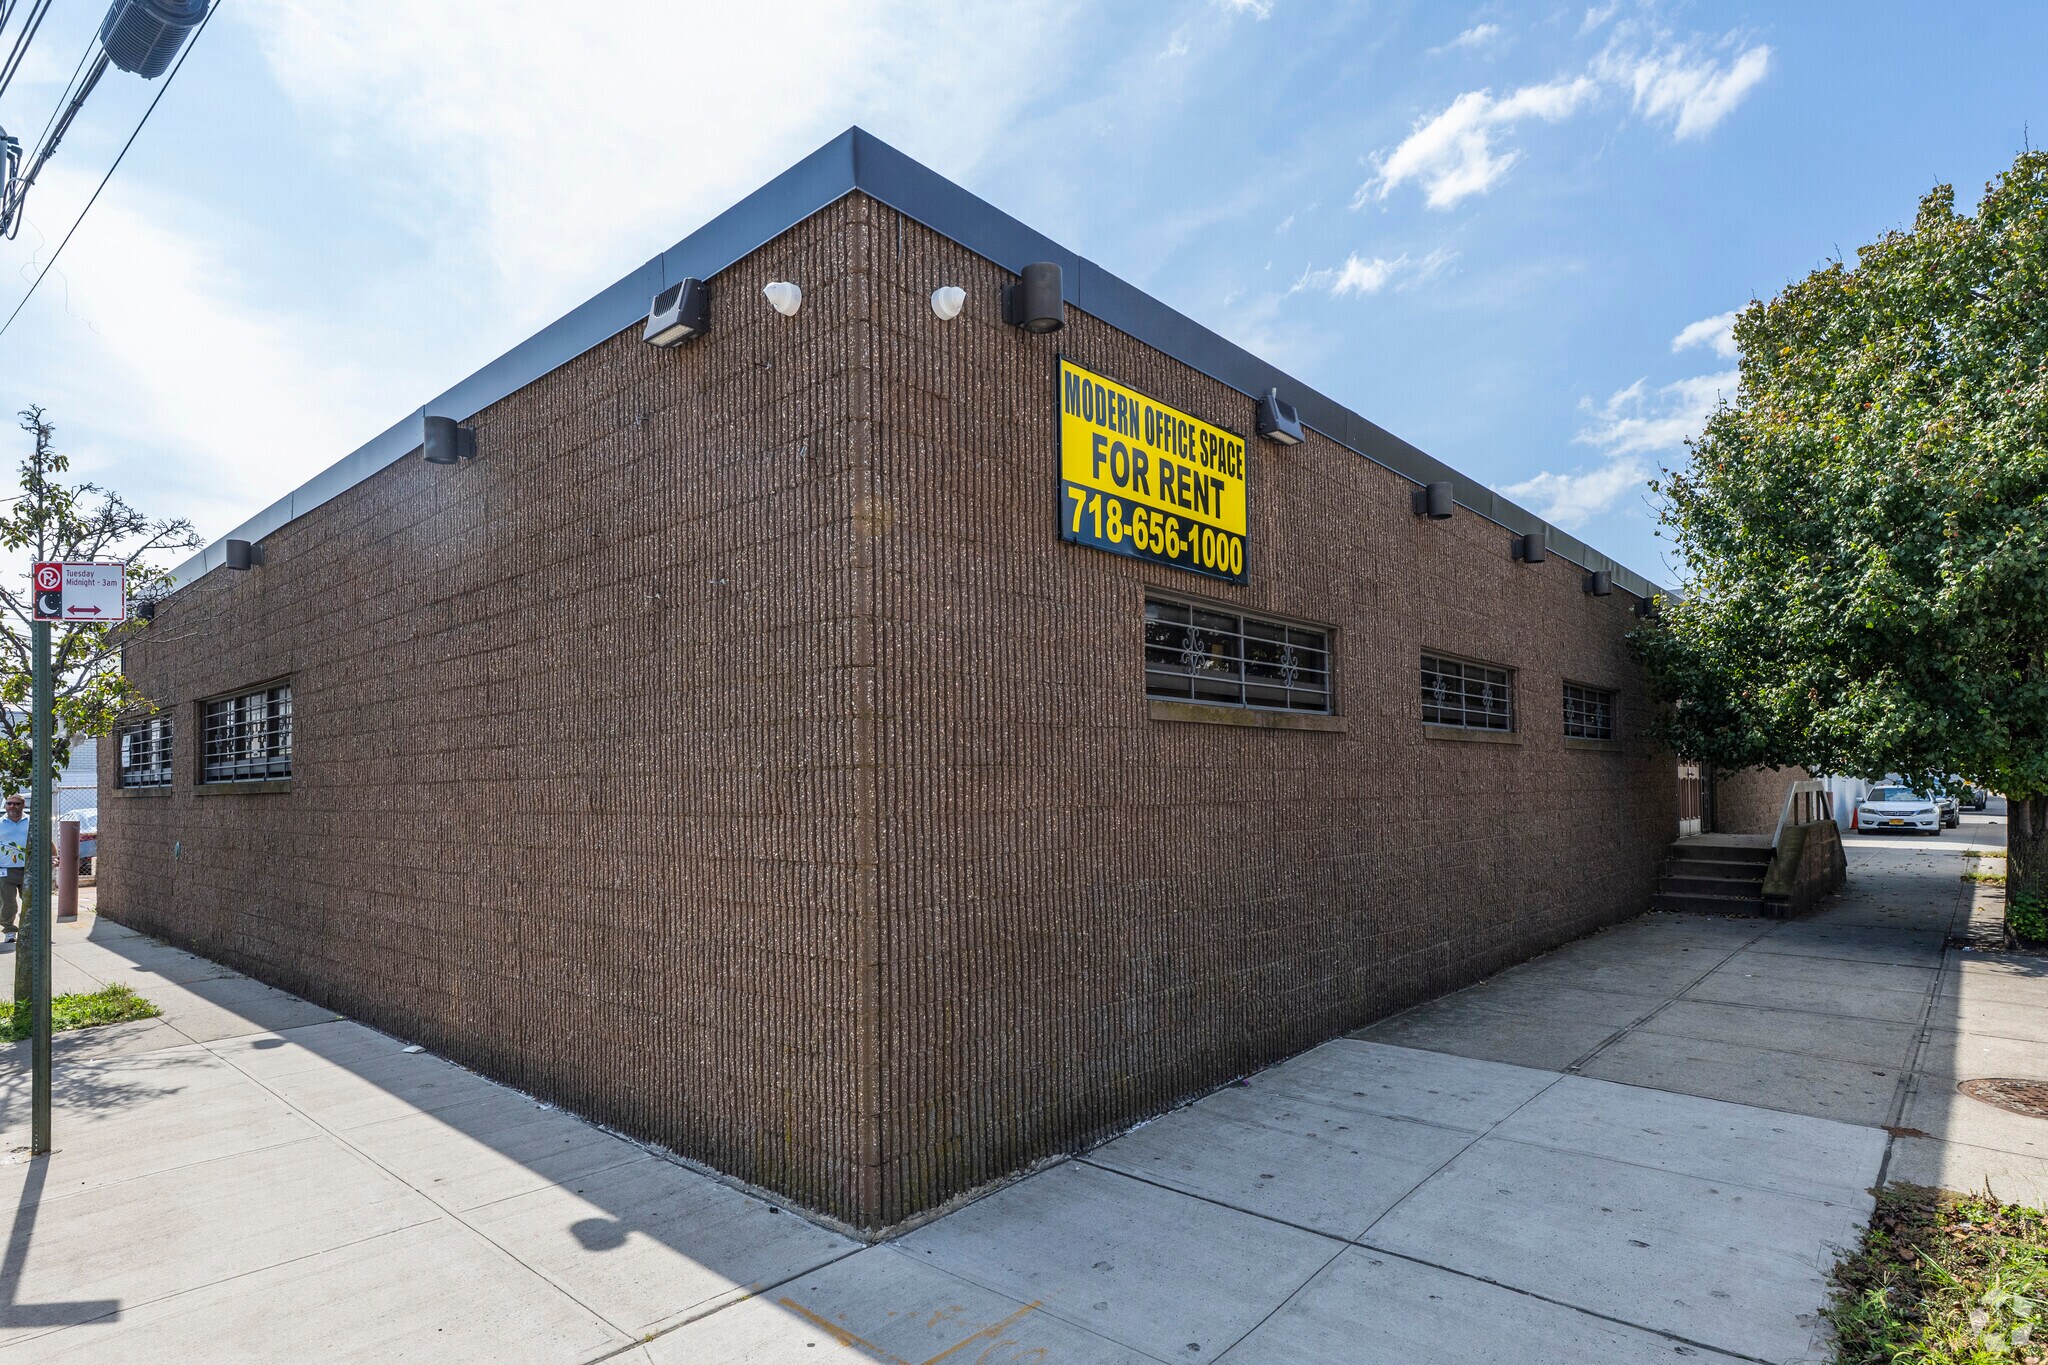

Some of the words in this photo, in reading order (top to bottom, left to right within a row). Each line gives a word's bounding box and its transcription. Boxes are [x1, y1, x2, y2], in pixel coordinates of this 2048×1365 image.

[1064, 370, 1140, 441] MODERN
[1144, 405, 1196, 463] OFFICE
[1199, 428, 1243, 481] SPACE
[1092, 432, 1150, 496] FOR
[1159, 457, 1225, 519] RENT
[66, 569, 95, 579] Tuesday
[1068, 486, 1243, 576] 718-656-1000
[66, 578, 95, 587] Midnight
[102, 579, 118, 587] 3am
